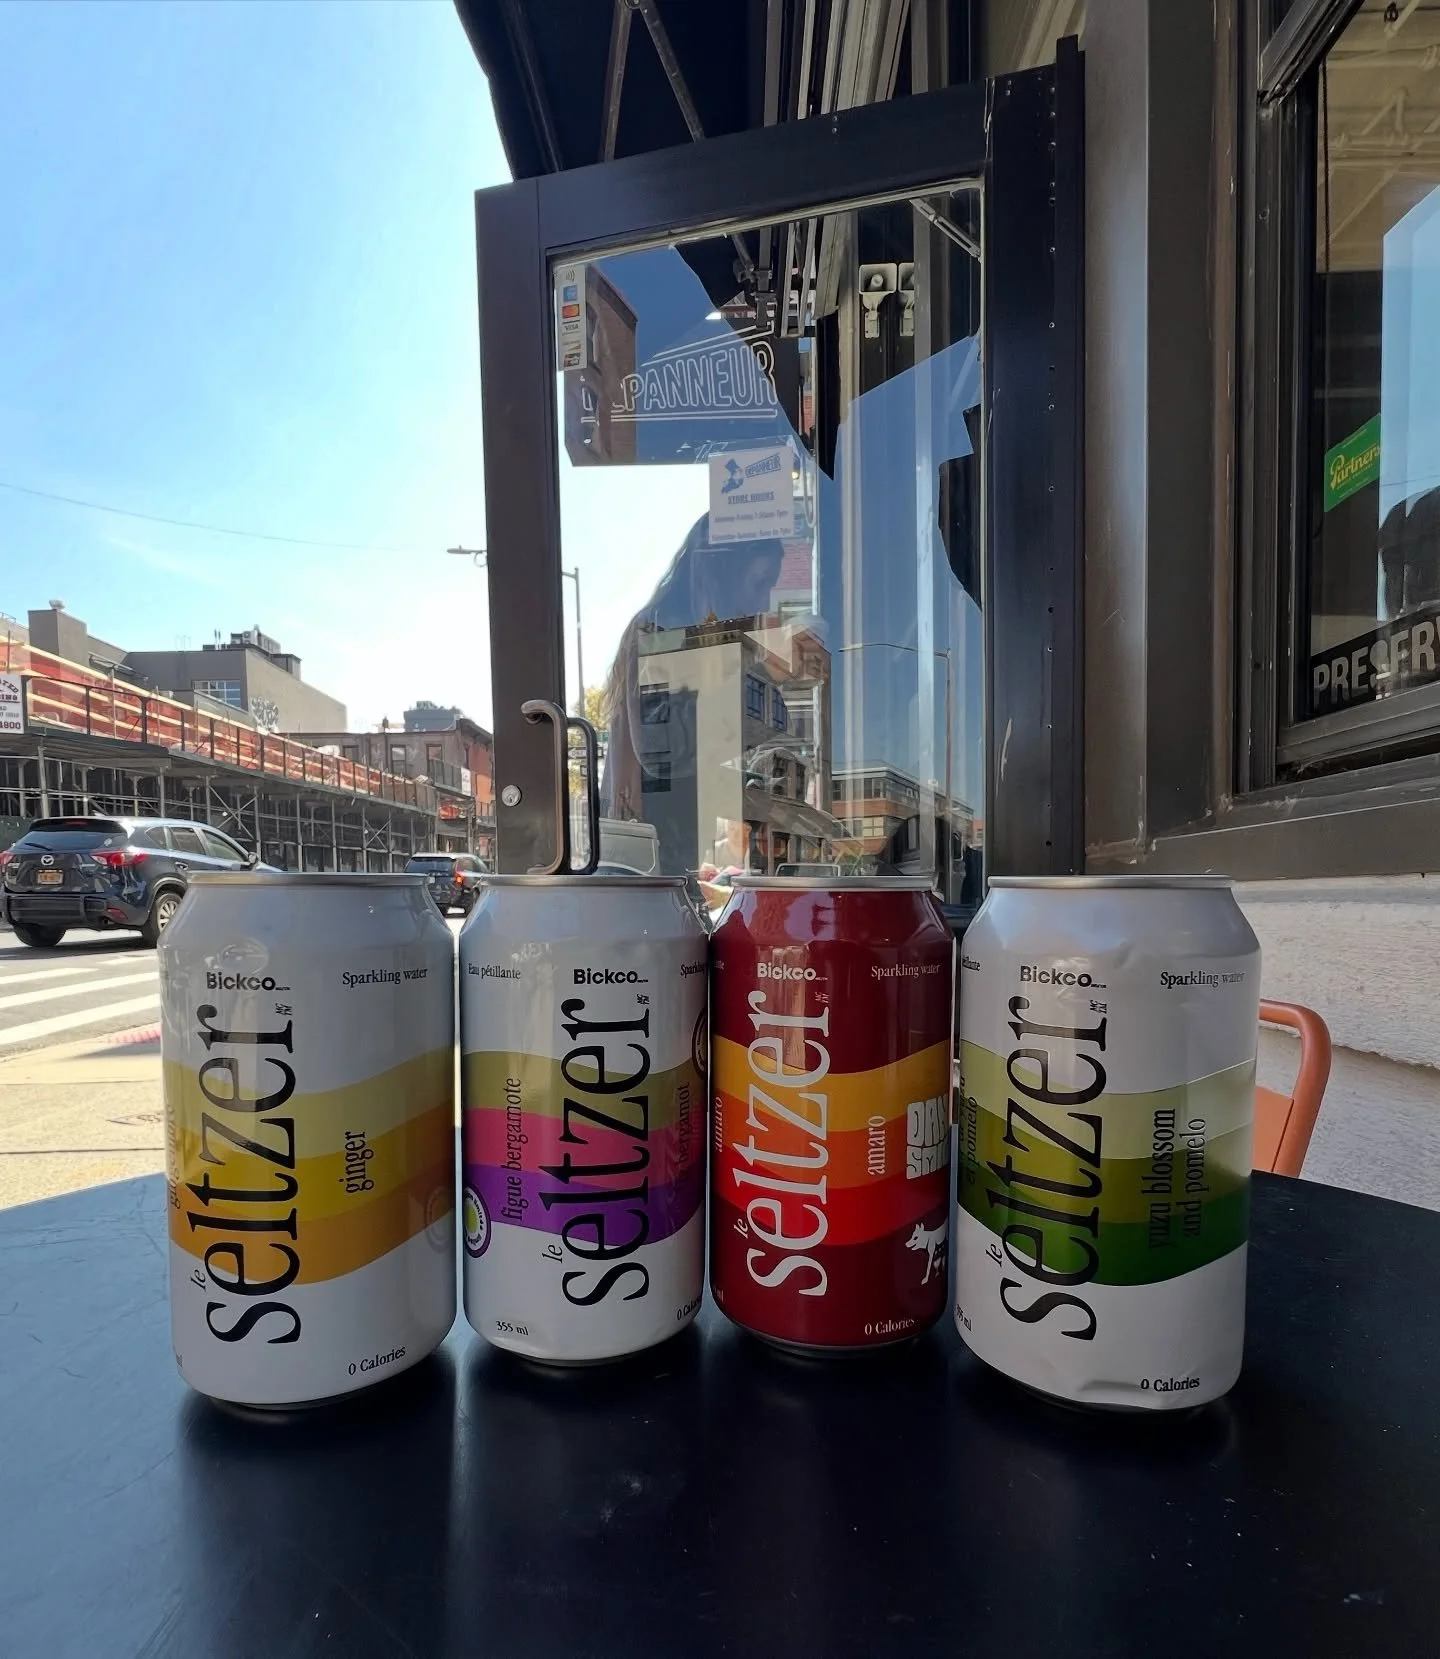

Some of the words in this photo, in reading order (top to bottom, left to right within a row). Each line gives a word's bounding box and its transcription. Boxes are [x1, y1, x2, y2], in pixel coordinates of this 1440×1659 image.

[206, 972, 276, 991] Bickco
[342, 970, 401, 988] Sparkling
[403, 967, 428, 980] water
[468, 963, 480, 976] Eau
[481, 964, 522, 979] pétillante
[573, 968, 639, 984] Bickco
[757, 962, 817, 981] Bickco
[871, 964, 919, 980] Sparkling
[921, 963, 941, 974] water
[1020, 965, 1092, 987] Bickco
[1160, 970, 1219, 989] Sparkling
[1222, 971, 1245, 985] water
[500, 1078, 529, 1171] bergamote
[965, 1096, 980, 1167] pomelo
[538, 997, 651, 1307] seltzer
[732, 991, 831, 1297] seltzer
[868, 1115, 886, 1175] amaro
[1141, 1108, 1176, 1194] blossom
[1179, 1118, 1209, 1194] pomelo
[185, 1003, 301, 1345] seltzer
[339, 1131, 374, 1194] ginger
[985, 995, 1107, 1341] seltzer
[501, 1175, 529, 1221] figue
[734, 1218, 748, 1240] le
[1149, 1201, 1177, 1249] yuzu
[1176, 1200, 1202, 1239] and
[542, 1245, 562, 1264] le
[985, 1243, 1003, 1268] le
[190, 1269, 206, 1292] le
[677, 1308, 683, 1321] 0
[864, 1322, 873, 1336] 0
[875, 1317, 915, 1334] Calories
[495, 1320, 514, 1333] 355
[516, 1325, 529, 1336] ml
[348, 1363, 357, 1376] 0
[360, 1347, 406, 1372] Calories
[1140, 1378, 1149, 1390] 0
[1153, 1377, 1201, 1393] Calories
